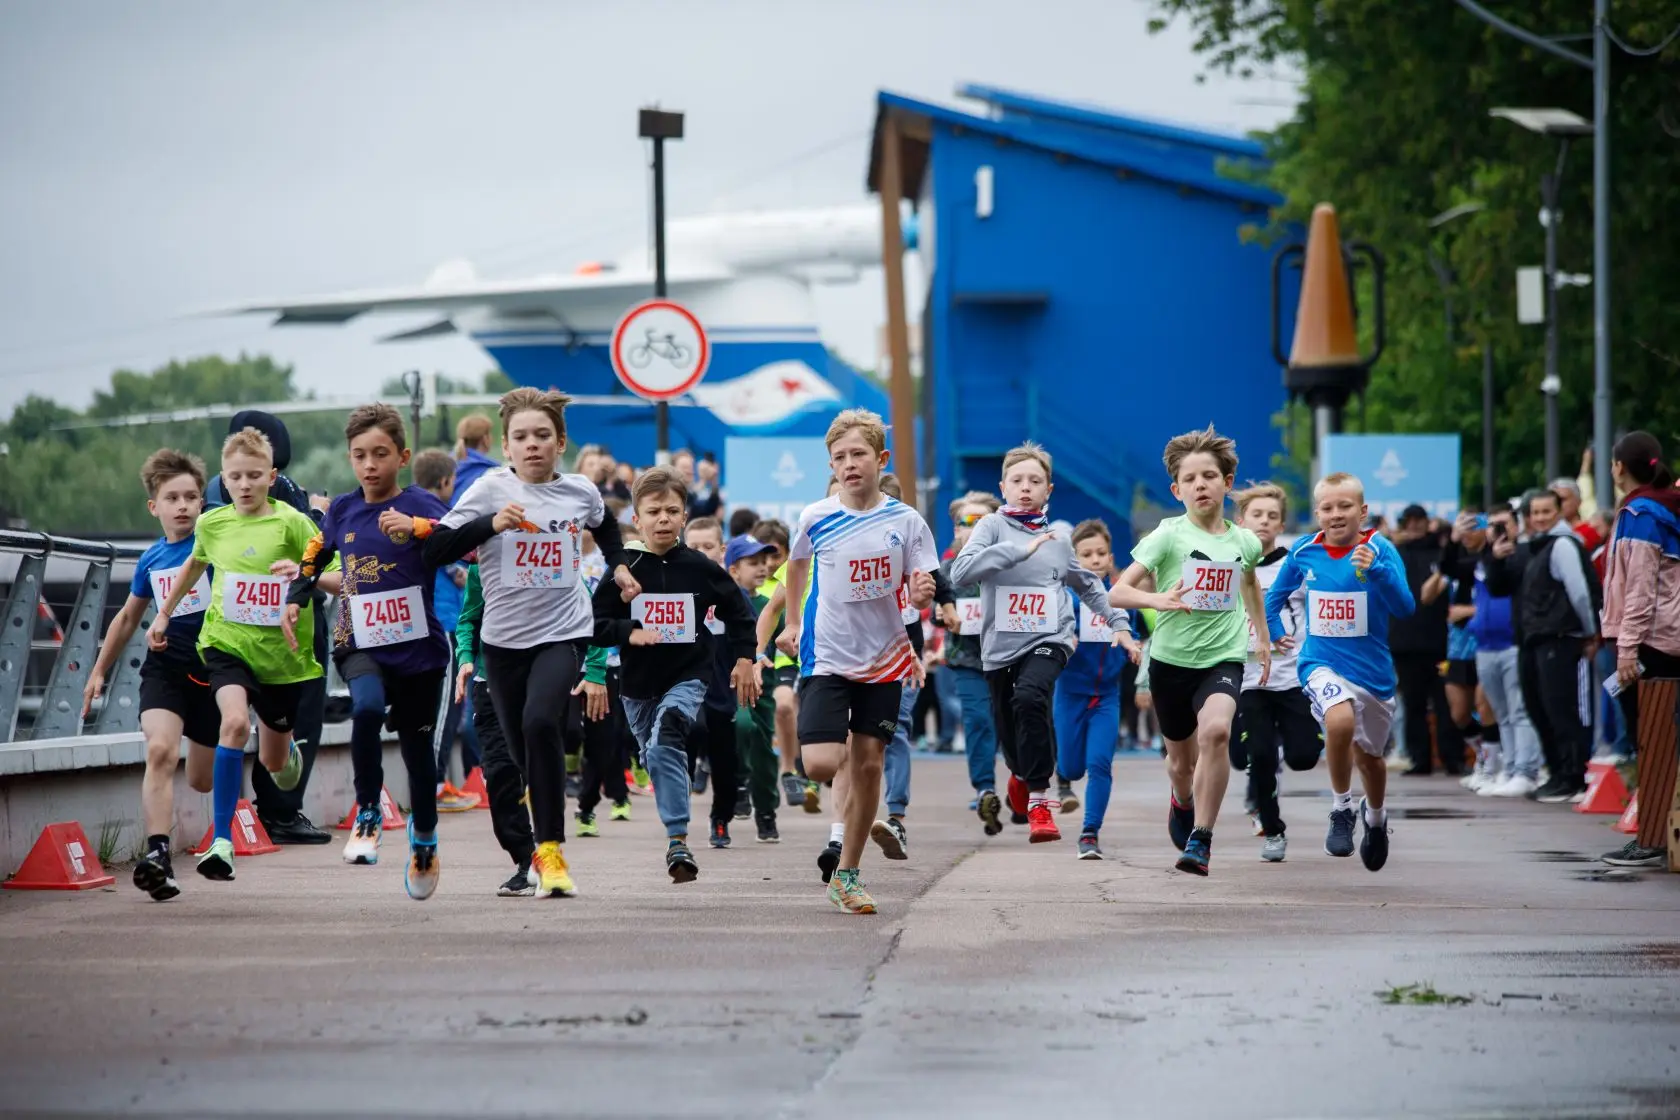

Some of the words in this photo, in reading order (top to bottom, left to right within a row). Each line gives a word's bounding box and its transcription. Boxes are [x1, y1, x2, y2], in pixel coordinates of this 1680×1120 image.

[515, 541, 562, 568] 2425
[848, 555, 892, 583] 2575
[1194, 567, 1233, 592] 2587
[236, 581, 281, 608] 2490
[1008, 593, 1046, 617] 2472
[363, 596, 411, 627] 2405
[643, 600, 685, 625] 2593
[1318, 598, 1355, 621] 2556
